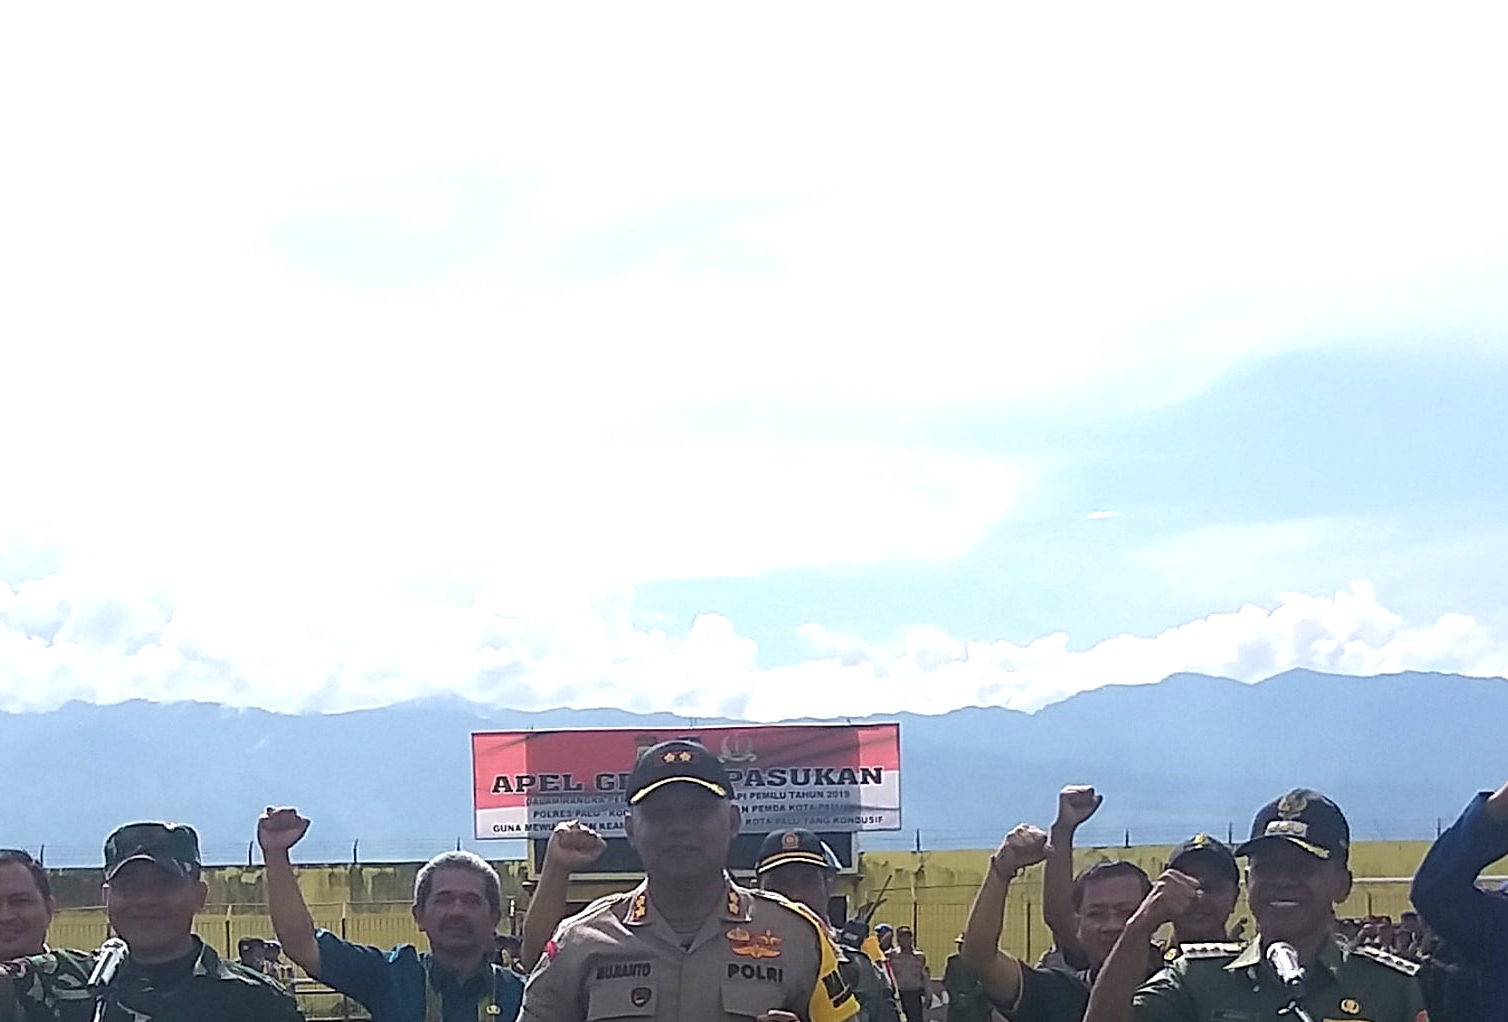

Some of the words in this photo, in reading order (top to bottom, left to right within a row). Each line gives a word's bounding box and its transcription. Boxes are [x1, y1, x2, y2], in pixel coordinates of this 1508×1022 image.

[492, 774, 583, 793] APEL
[724, 767, 883, 787] PASUKAN
[749, 791, 786, 799] PEMILU
[788, 790, 824, 799] TAHUN
[827, 790, 850, 798] 2019
[533, 810, 572, 818] POLRES
[575, 809, 600, 817] PALU
[752, 804, 786, 813] PEMDA
[788, 803, 814, 812] KOTA
[493, 823, 522, 832] GUNA
[745, 818, 771, 826] KOTA
[804, 817, 831, 825] YANG
[833, 815, 884, 825] KONDUSIF
[727, 962, 783, 984] POLRI
